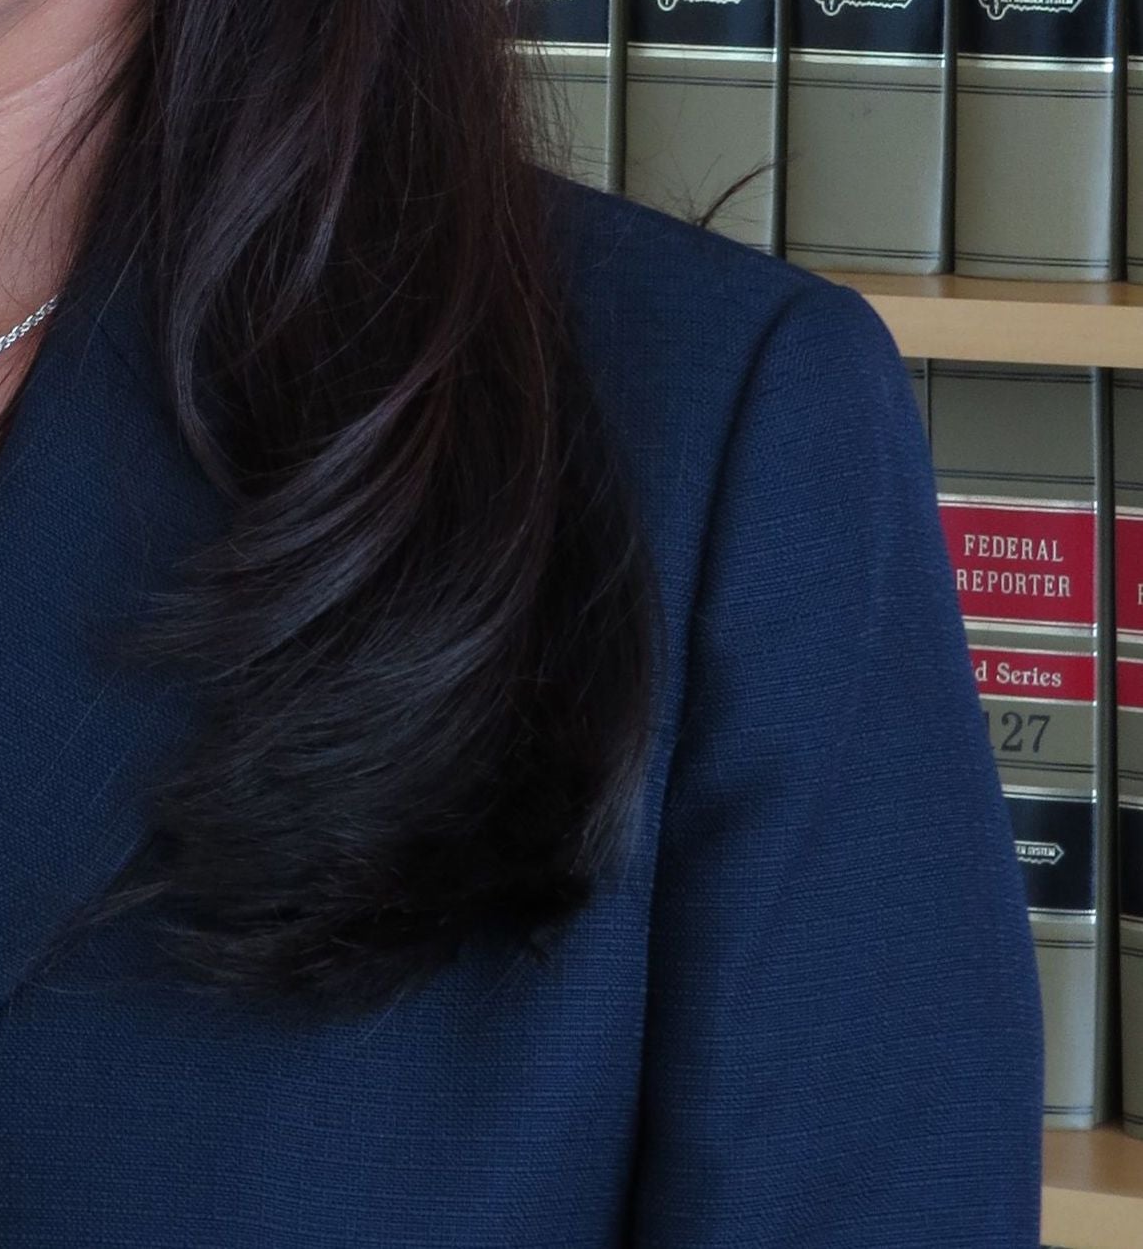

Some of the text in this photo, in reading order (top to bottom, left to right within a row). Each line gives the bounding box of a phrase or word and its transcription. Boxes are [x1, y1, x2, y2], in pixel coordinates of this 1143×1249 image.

[964, 534, 1064, 562] FEDERAL
[957, 568, 1071, 598] REPORTER
[972, 660, 1063, 688] d Series
